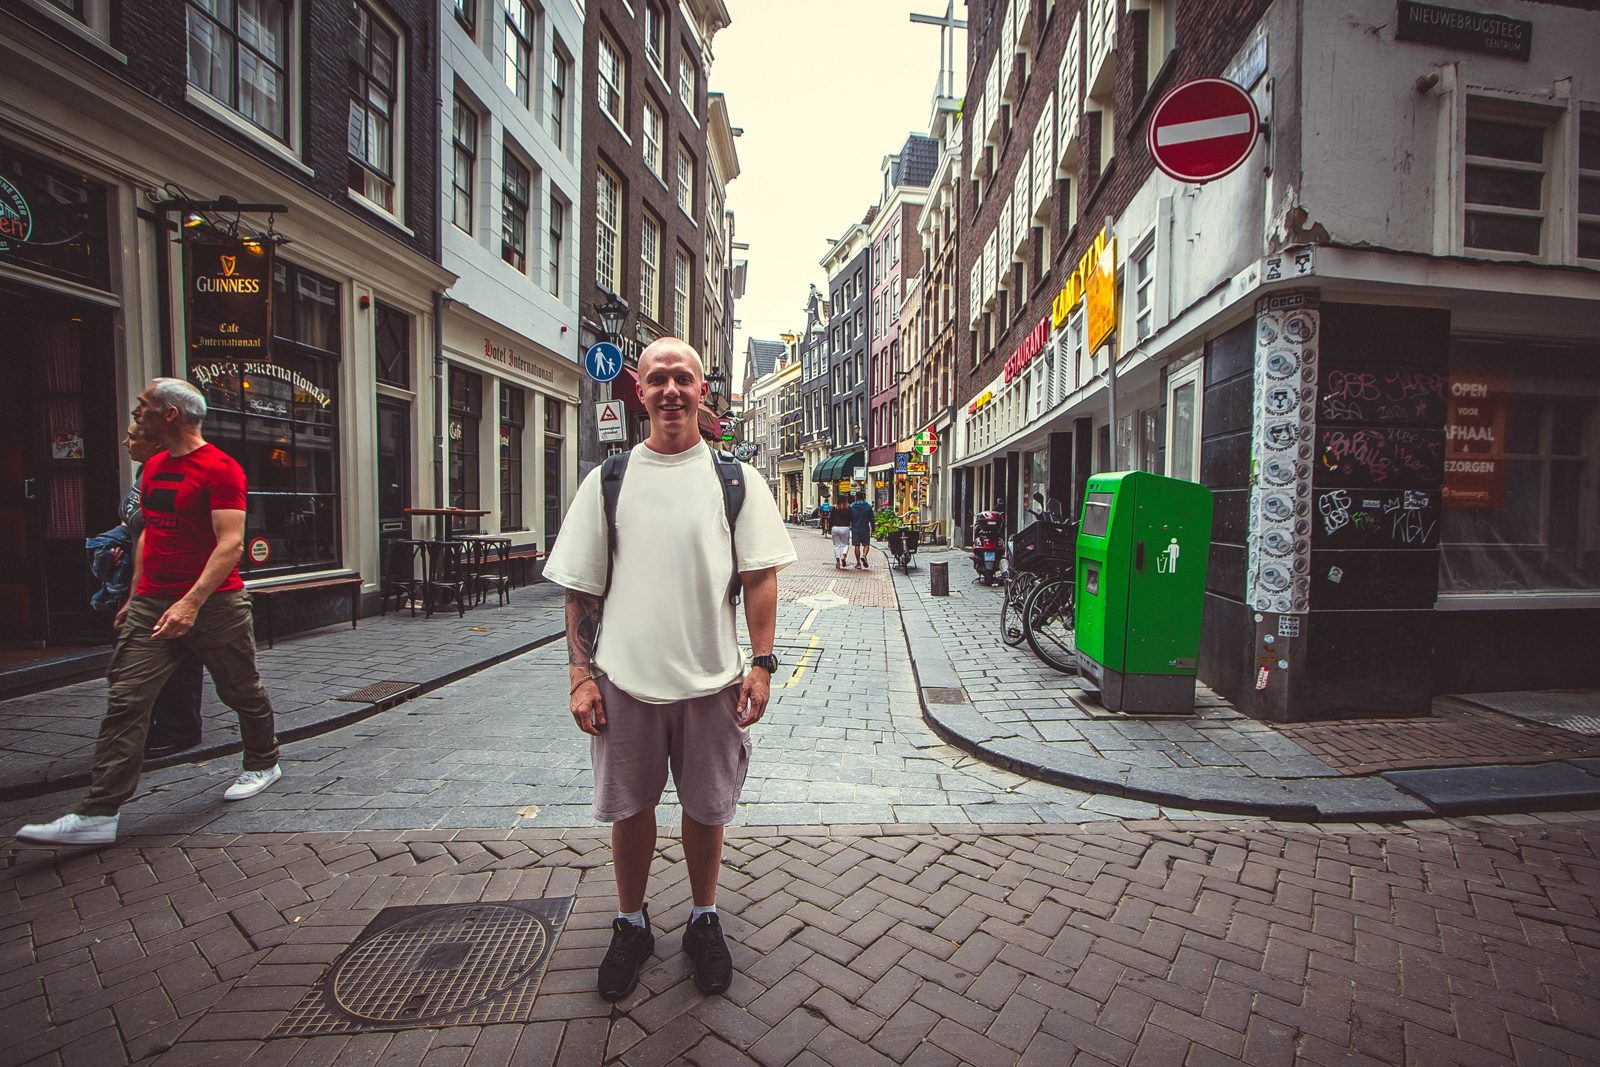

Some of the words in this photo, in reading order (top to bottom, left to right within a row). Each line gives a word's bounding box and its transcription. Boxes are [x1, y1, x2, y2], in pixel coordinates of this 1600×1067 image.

[1409, 6, 1522, 39] NIEUWEBRUGSTEEG
[1484, 38, 1521, 51] CENTRUM
[12, 194, 27, 216] BEER
[196, 275, 260, 293] GUINNESS
[198, 336, 261, 348] Internationaal
[610, 334, 638, 362] OTEL
[1004, 316, 1049, 384] RESTAURANT
[484, 337, 506, 364] Hotel
[508, 348, 554, 384] Internationaal
[1451, 382, 1488, 398] OPEN
[1457, 407, 1479, 416] VOOR
[1443, 461, 1494, 473] EZORGEN
